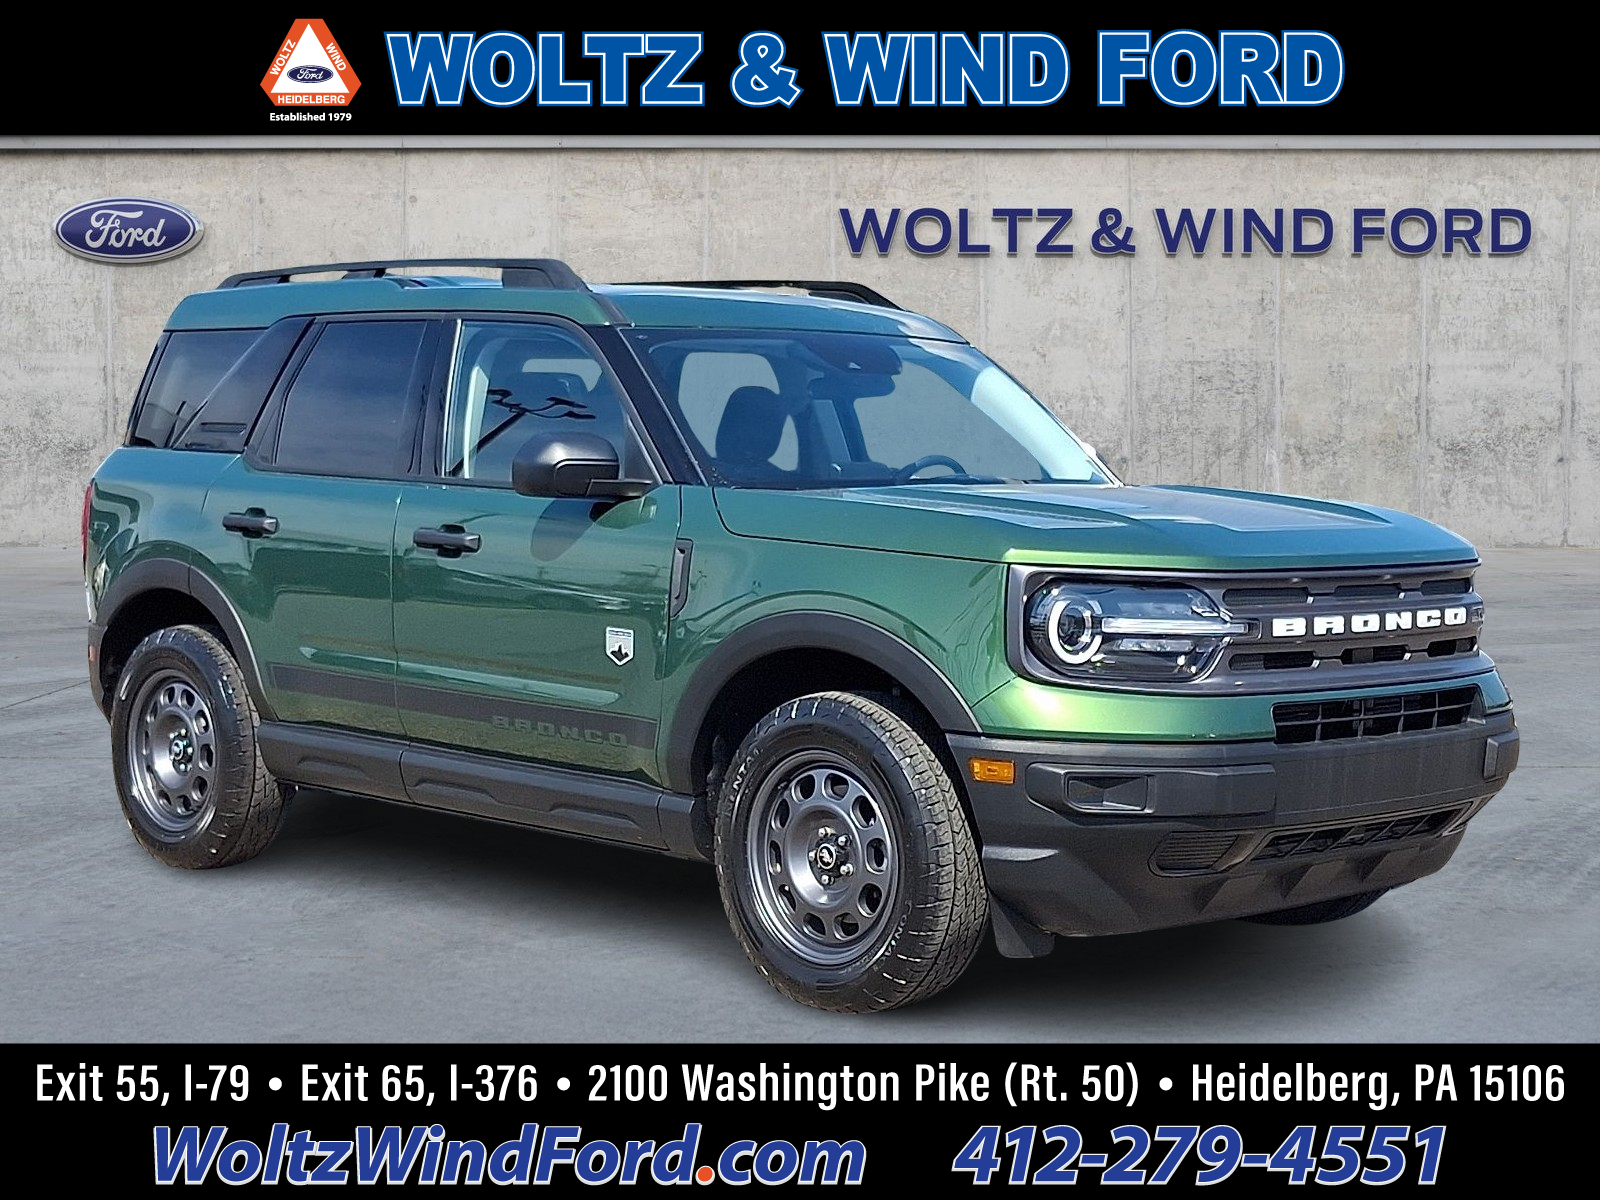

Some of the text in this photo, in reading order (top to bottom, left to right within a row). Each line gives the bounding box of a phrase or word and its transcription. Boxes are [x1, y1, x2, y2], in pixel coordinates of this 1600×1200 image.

[85, 209, 166, 248] Ford
[840, 207, 1532, 255] WOLTZ & WIND FORD
[1272, 606, 1467, 637] BRONCO
[491, 715, 628, 748] BRONCO
